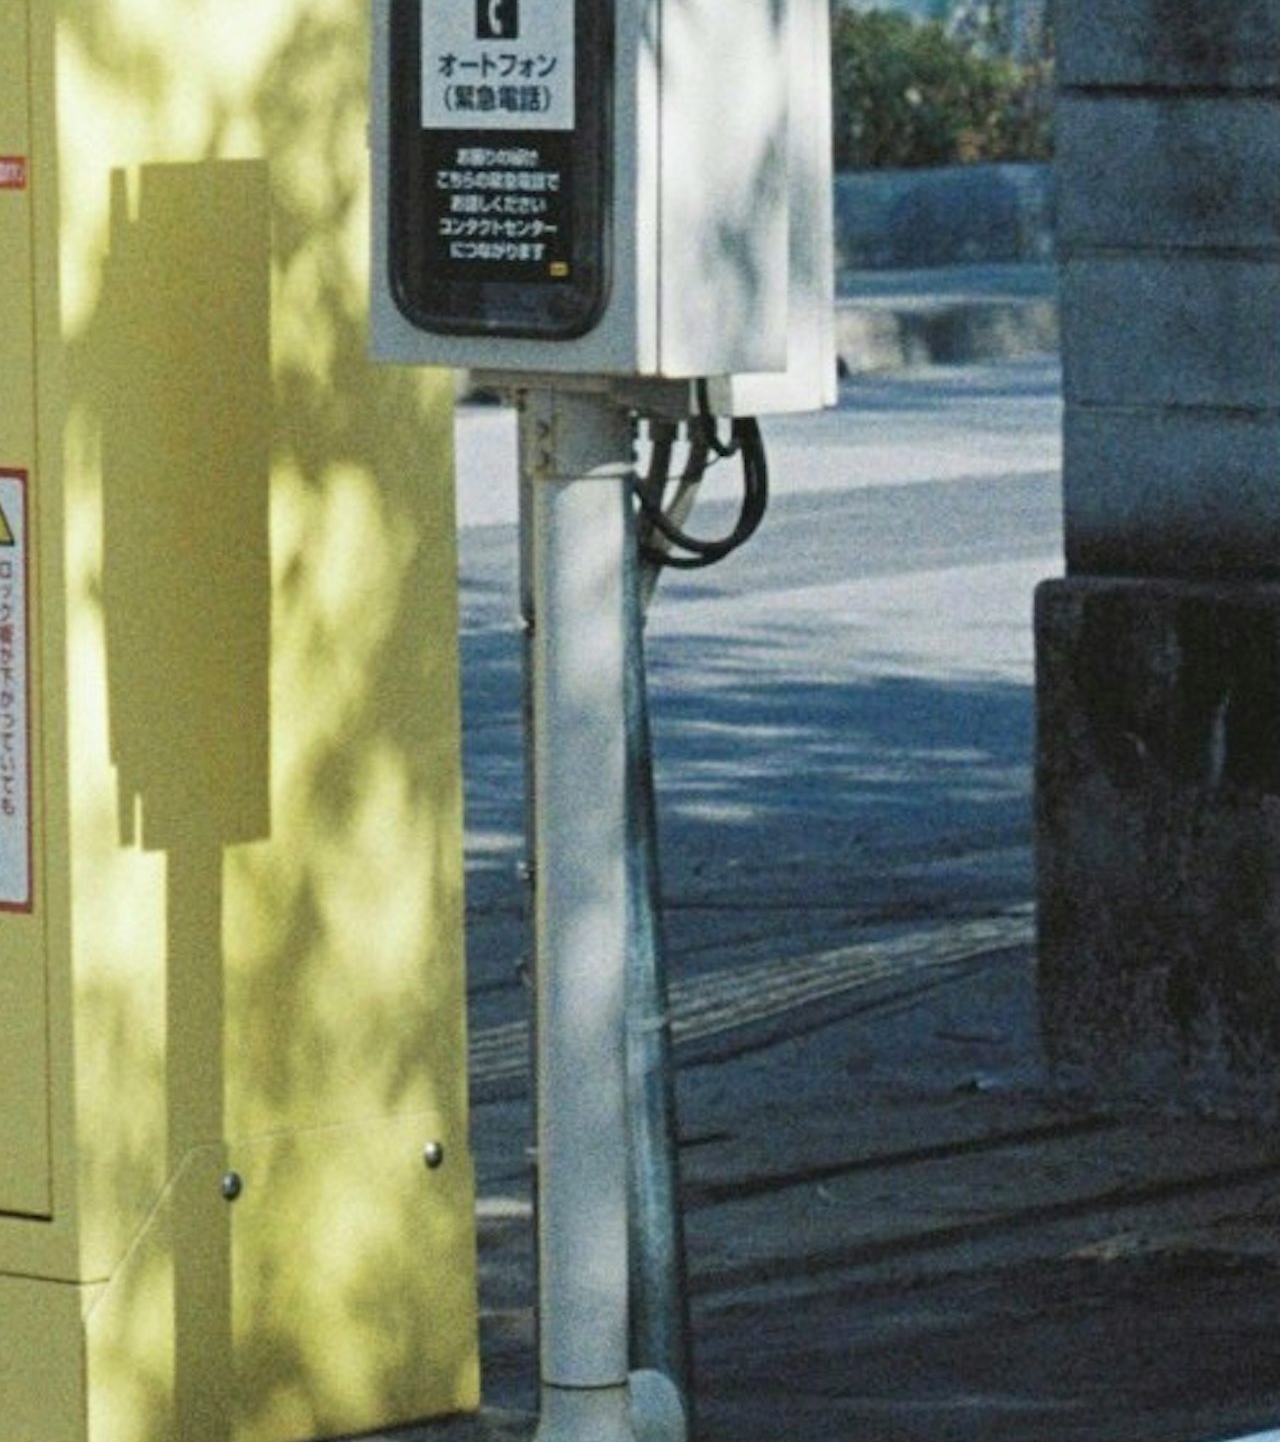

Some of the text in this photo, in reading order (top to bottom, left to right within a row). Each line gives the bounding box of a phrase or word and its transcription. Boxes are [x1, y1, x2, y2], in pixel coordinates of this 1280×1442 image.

[438, 53, 557, 78] オートフォン
[444, 84, 552, 113] （緊急電話）
[439, 219, 557, 237] コンタクトセンター
[450, 242, 546, 262] につながります
